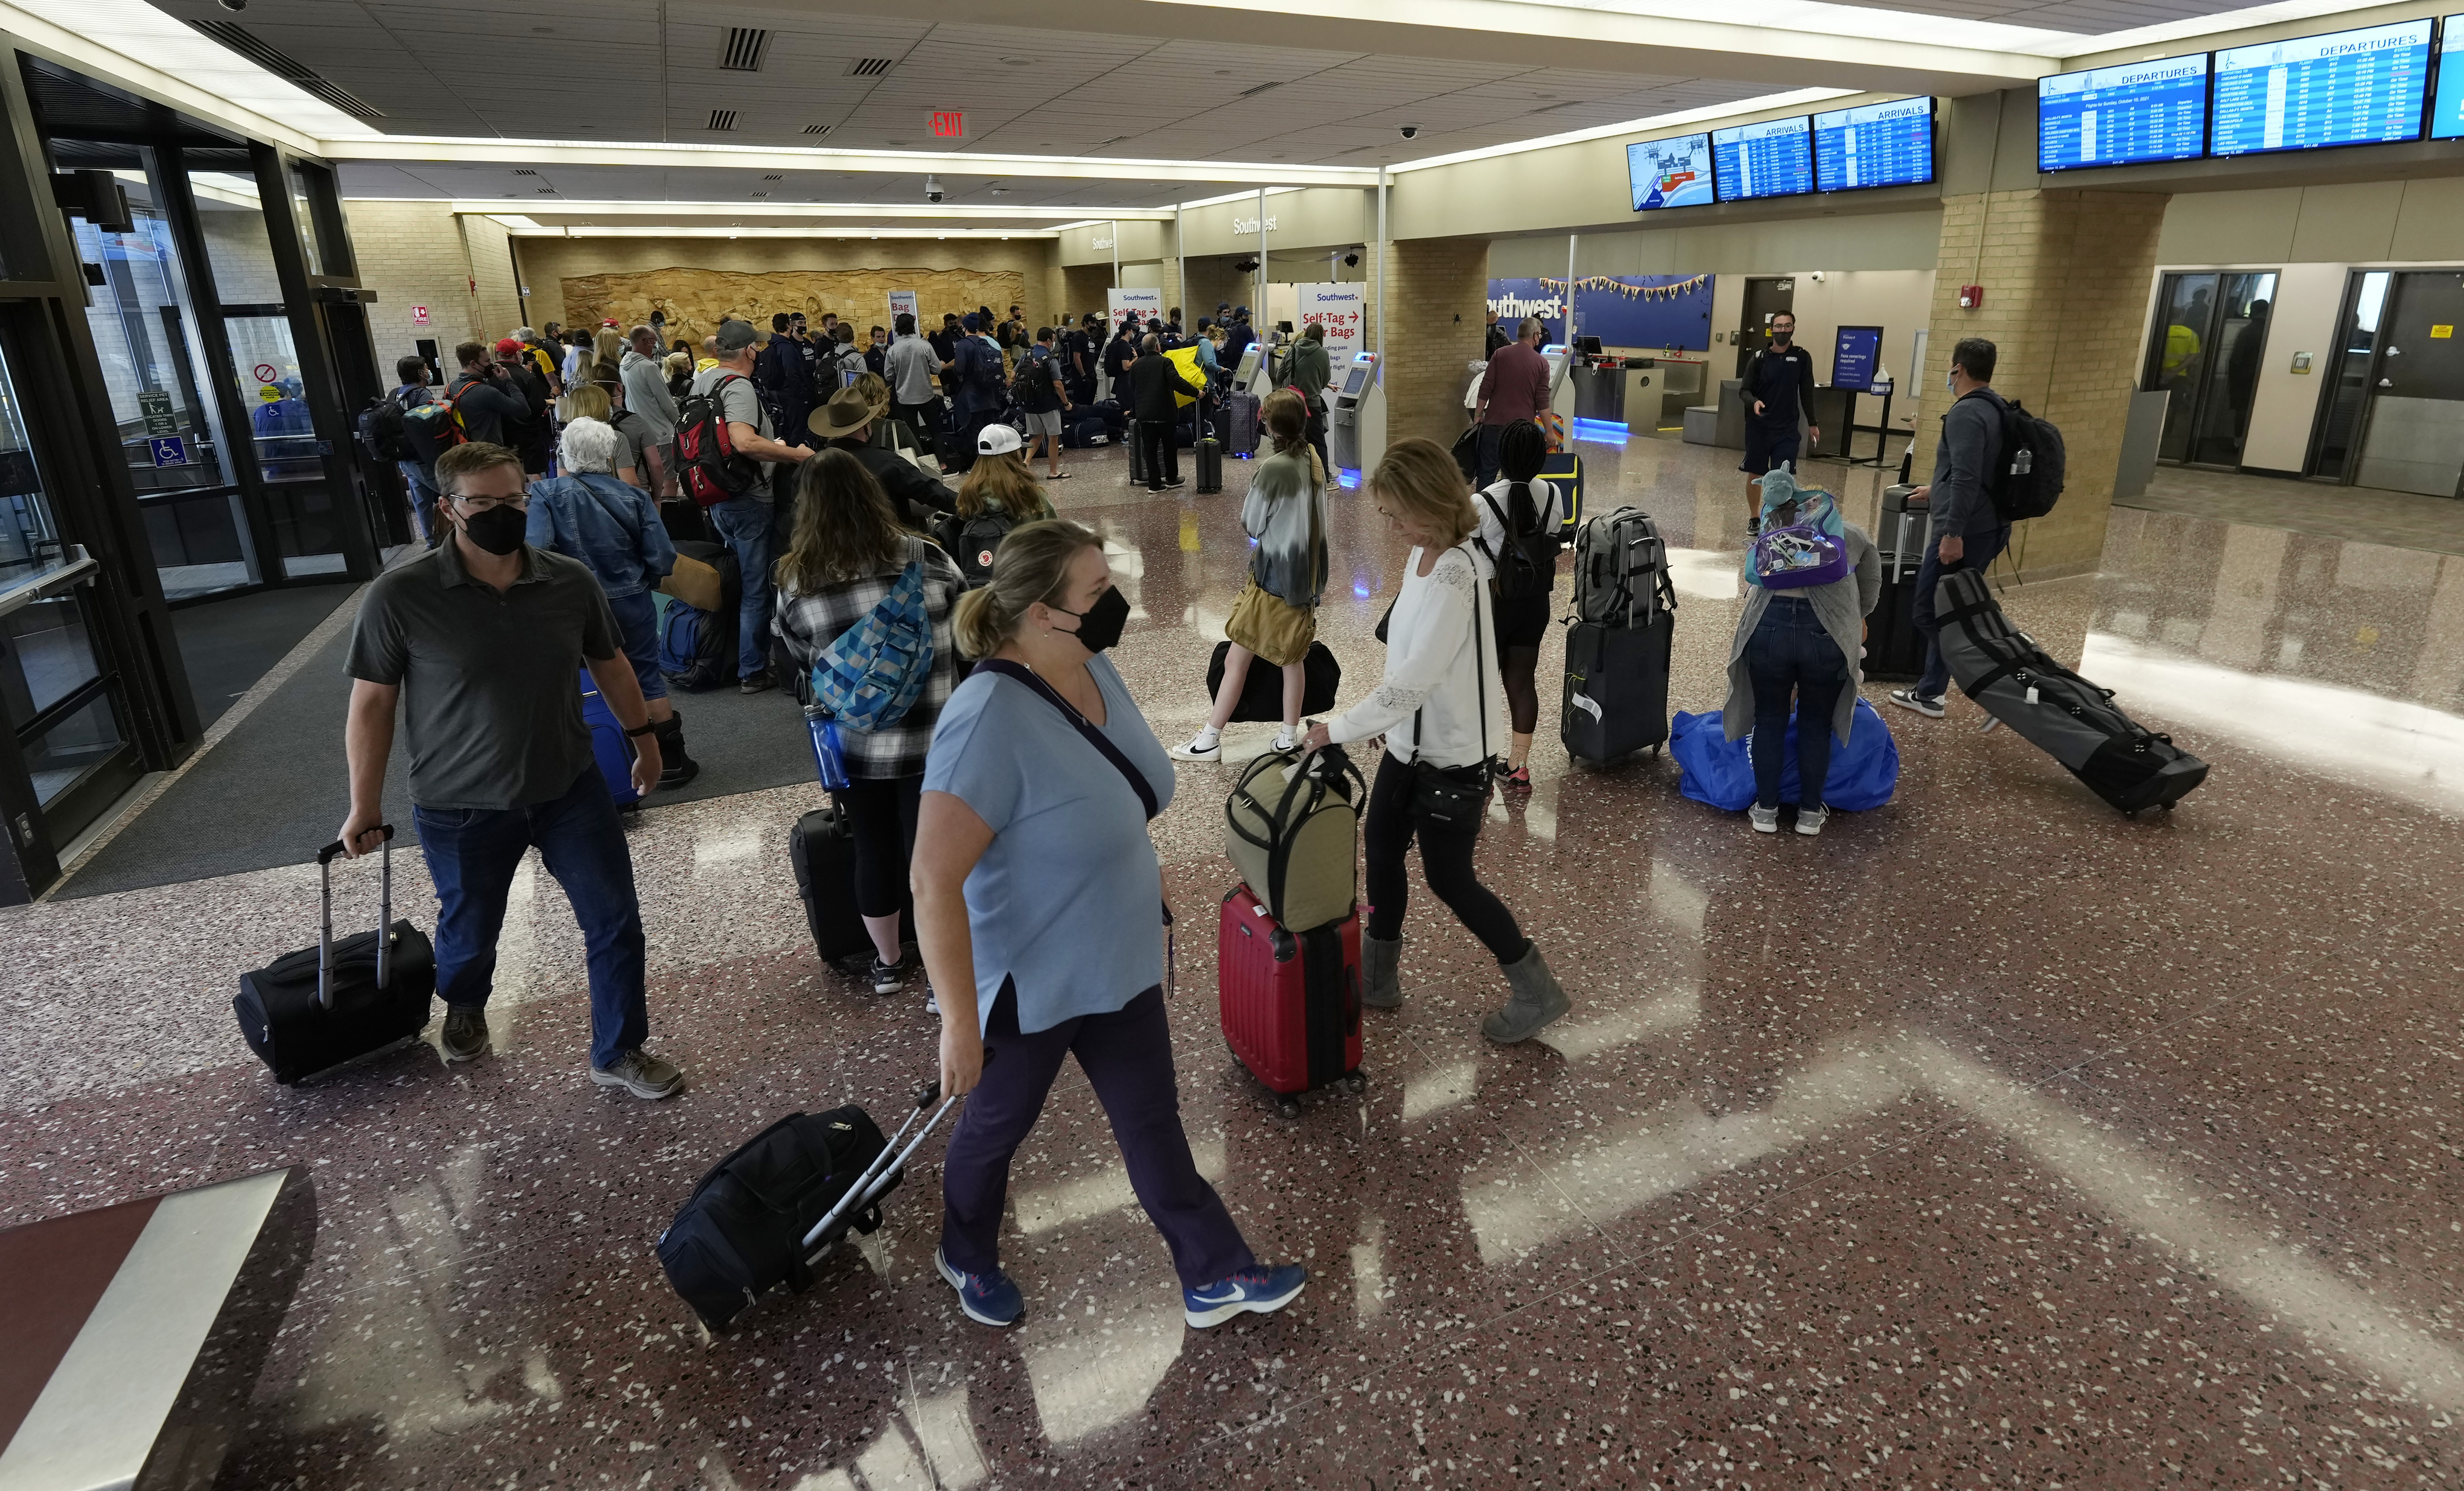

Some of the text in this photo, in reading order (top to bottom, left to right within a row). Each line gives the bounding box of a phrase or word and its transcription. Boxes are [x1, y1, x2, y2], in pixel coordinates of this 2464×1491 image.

[2320, 34, 2418, 56] DEPARTURES
[2122, 66, 2197, 84] DEPARTURES
[1878, 106, 1923, 119] ARRIVALS
[933, 112, 963, 136] EXIT
[1766, 124, 1803, 136] ARRIVALS
[1093, 238, 1113, 250] Southwe
[1540, 279, 1586, 291] HAPY
[892, 303, 909, 312] Bag
[1487, 292, 1561, 319] outhwest
[1303, 313, 1345, 325] Self-Tag
[1331, 327, 1355, 339] Bags
